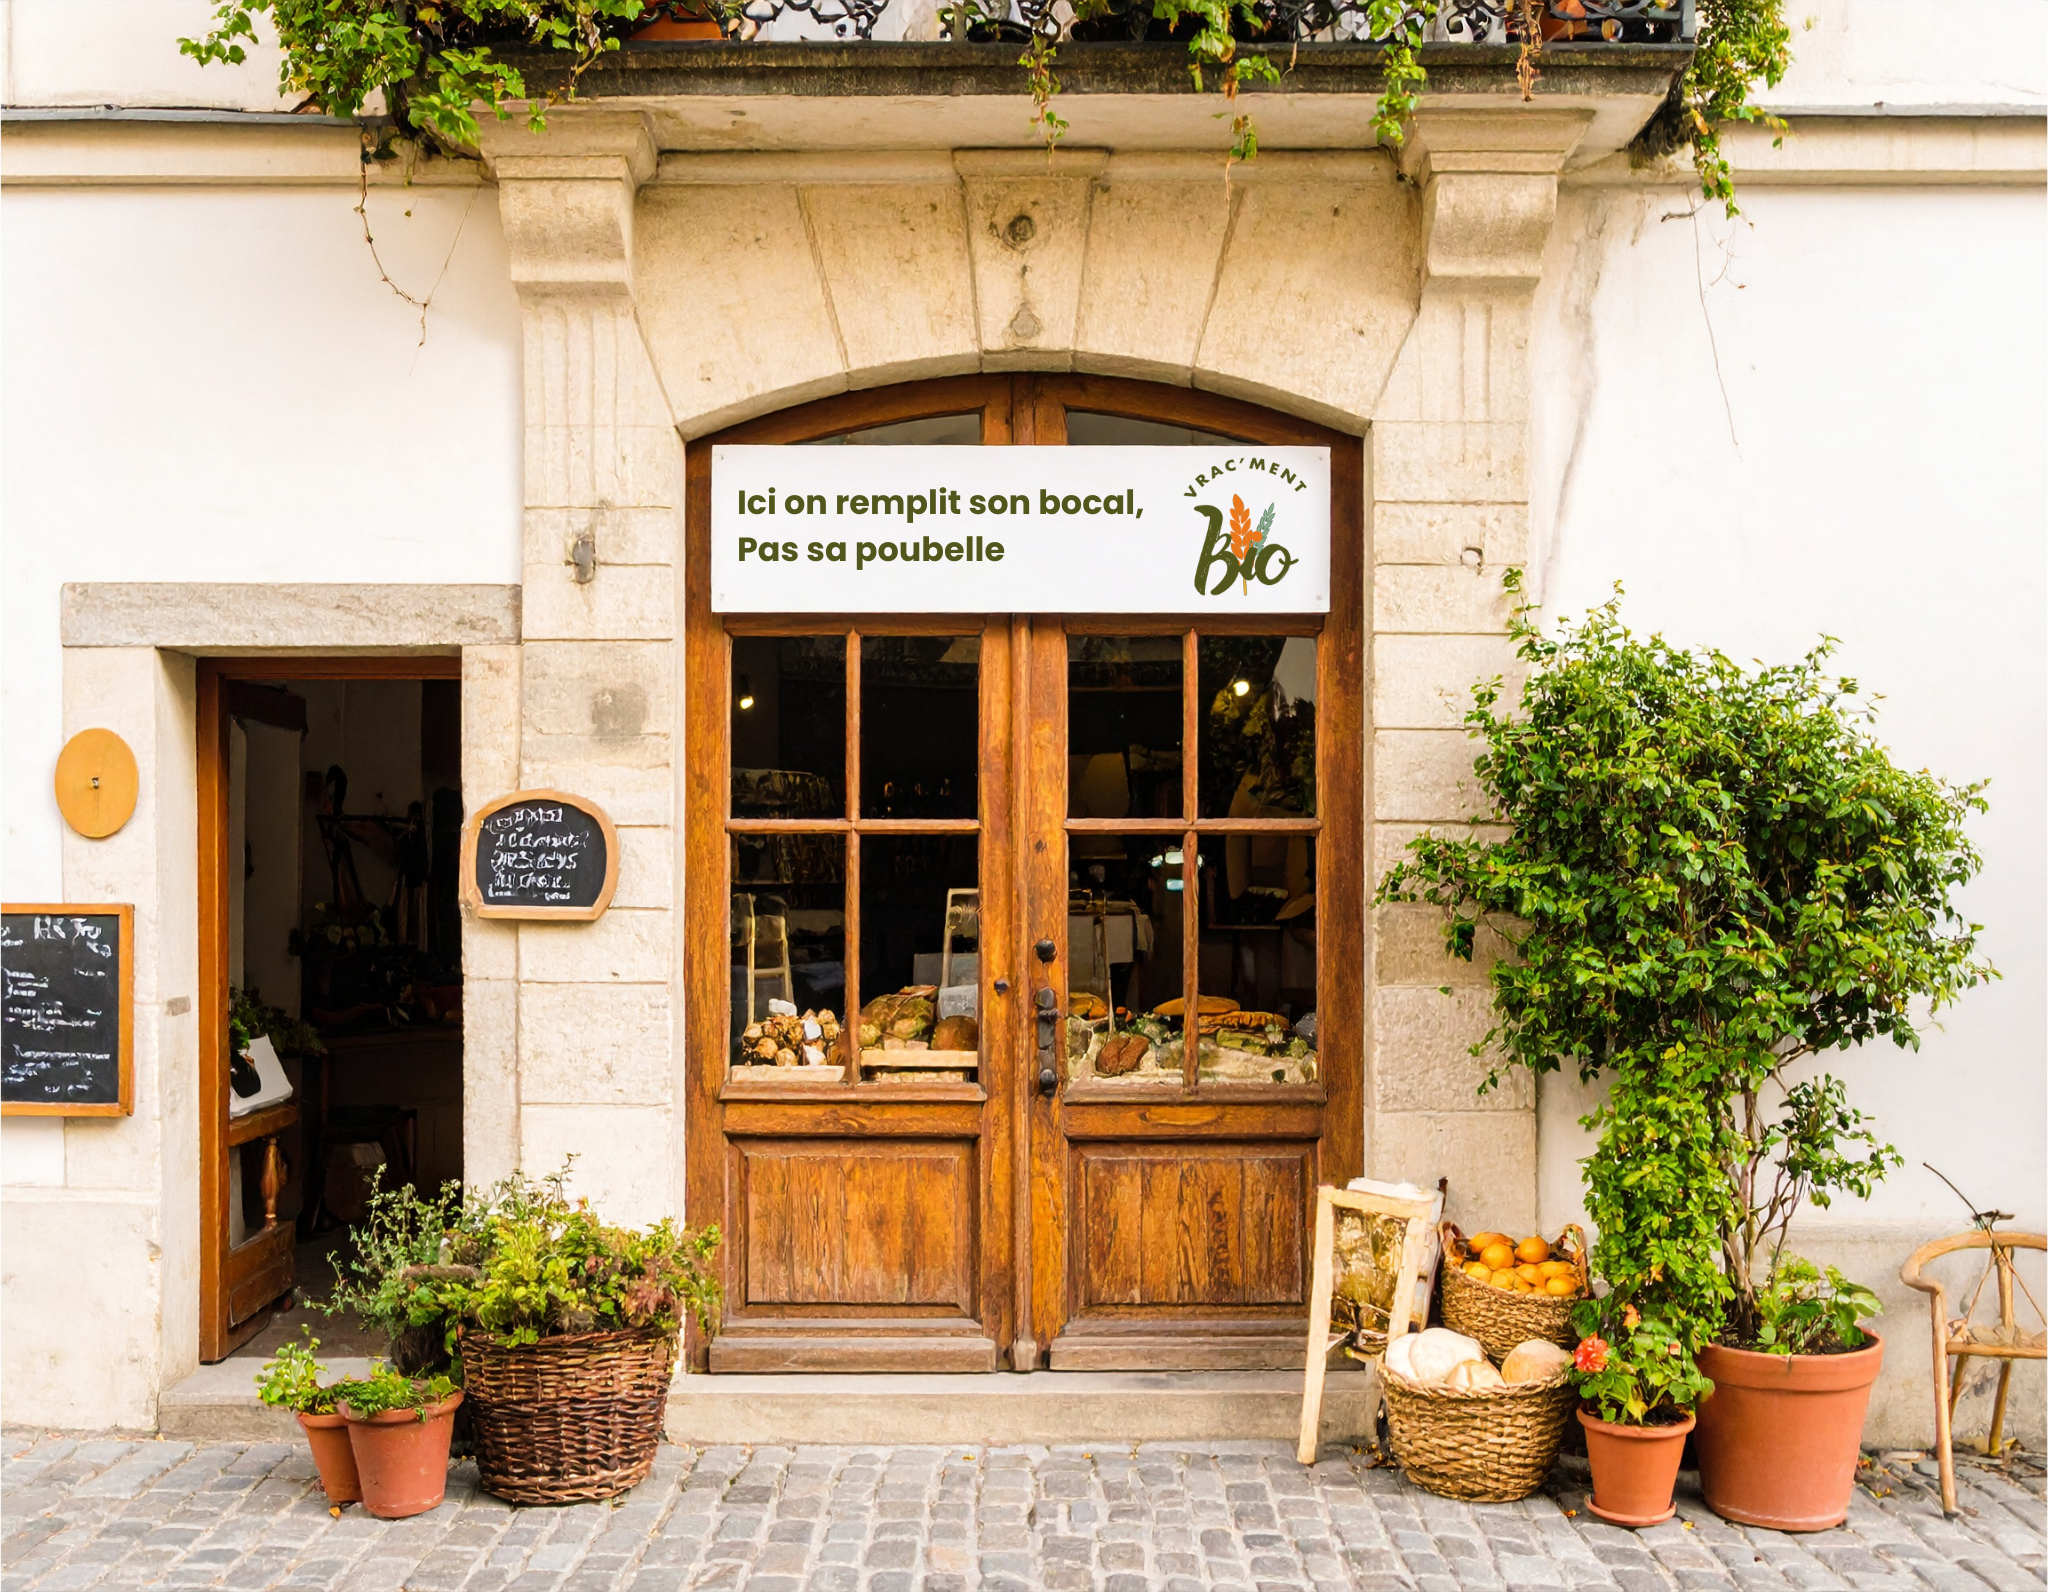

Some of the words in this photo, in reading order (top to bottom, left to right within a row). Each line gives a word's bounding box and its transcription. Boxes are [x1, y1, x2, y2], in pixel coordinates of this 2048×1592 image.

[1184, 457, 1307, 497] VRAC'MENT
[738, 486, 776, 515] Ici
[784, 494, 827, 515] on
[836, 486, 961, 524] remplit
[969, 494, 1030, 515] son
[1039, 486, 1144, 519] bocal,
[738, 536, 799, 562] Pas
[806, 541, 847, 562] sa
[856, 535, 1005, 571] poubelle
[1193, 504, 1299, 596] Bio
